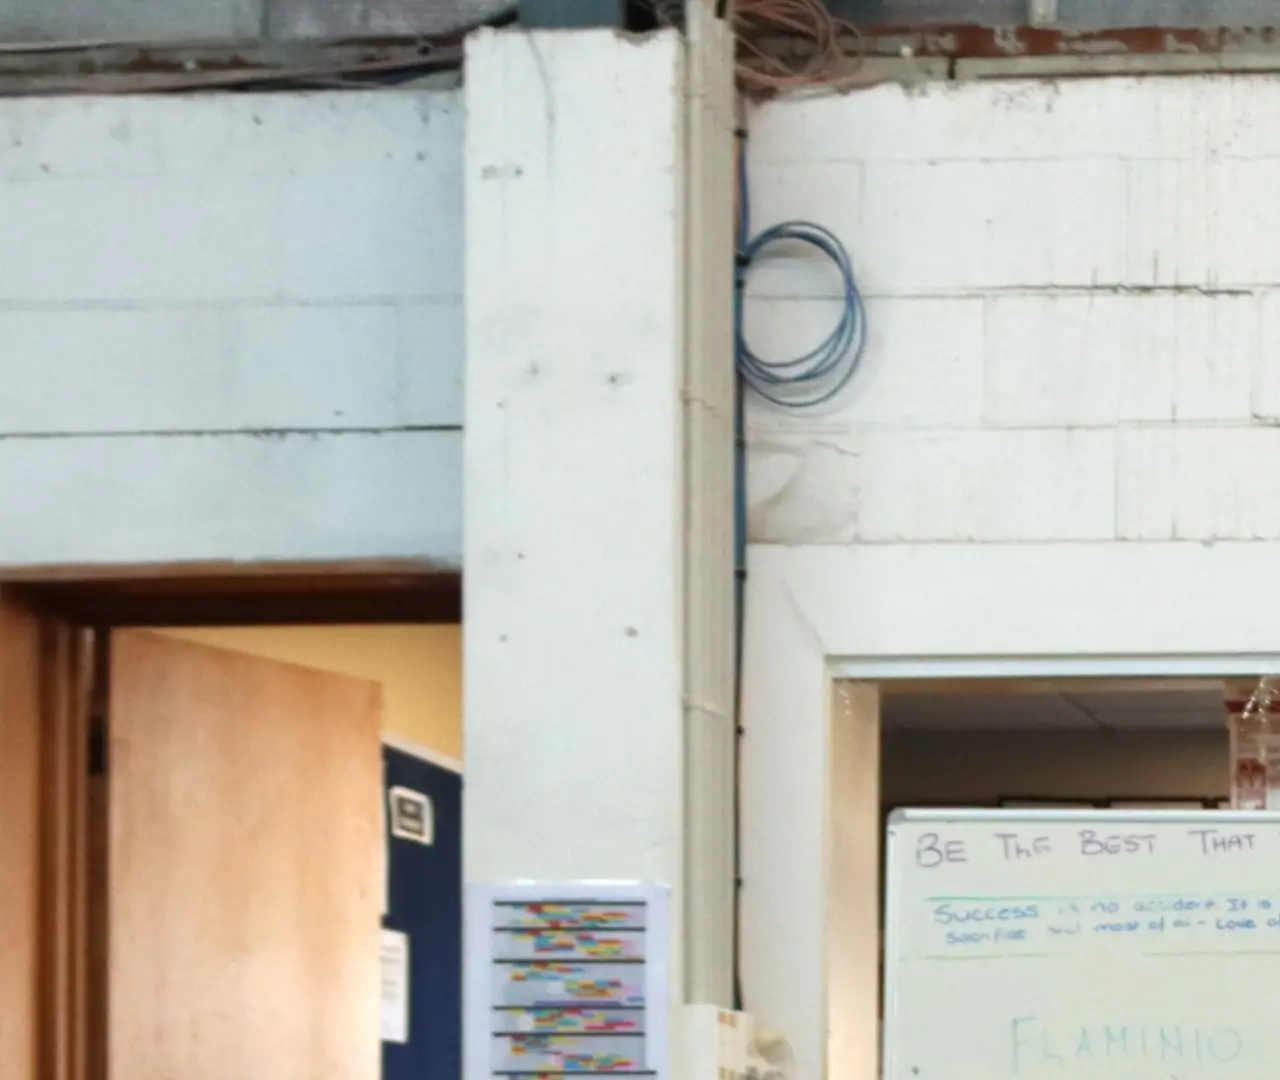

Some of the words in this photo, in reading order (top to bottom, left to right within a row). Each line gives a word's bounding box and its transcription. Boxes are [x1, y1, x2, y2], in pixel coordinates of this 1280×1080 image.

[915, 831, 968, 868] BE
[1079, 829, 1157, 855] BEST
[1188, 829, 1256, 855] THAT
[1010, 1015, 1244, 1075] FLAMINIO
